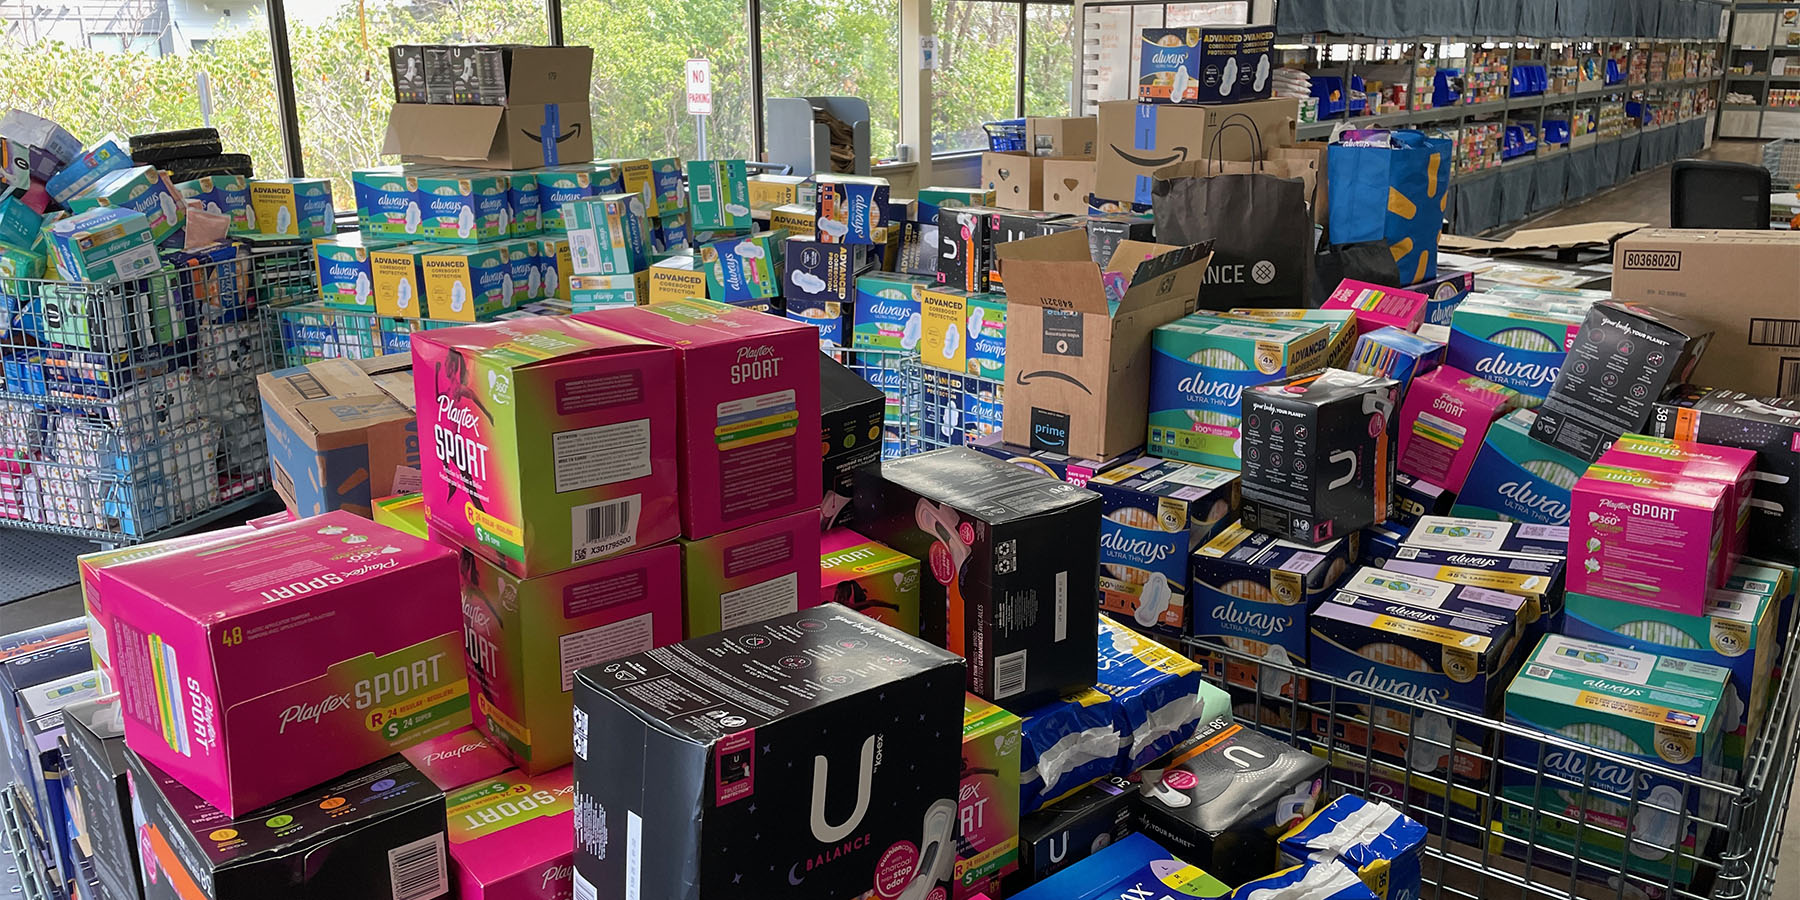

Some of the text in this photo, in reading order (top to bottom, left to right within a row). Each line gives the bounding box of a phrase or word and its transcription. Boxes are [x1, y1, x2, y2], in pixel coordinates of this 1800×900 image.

[1204, 34, 1242, 43] ADVANCED
[398, 48, 404, 57] U
[454, 48, 460, 57] U
[1152, 50, 1184, 67] always
[692, 70, 704, 83] NO
[688, 93, 710, 104] PARKING
[624, 163, 649, 172] ADVANCED
[661, 176, 680, 188] always
[254, 186, 291, 195] ADVANCED
[551, 191, 582, 201] always
[133, 192, 160, 214] always
[304, 199, 331, 214] always
[378, 194, 409, 211] always
[430, 198, 462, 215] always
[480, 198, 502, 211] always
[519, 193, 539, 205] always
[76, 213, 117, 231] always
[774, 216, 815, 227] ADVANCE
[855, 194, 865, 238] always
[629, 213, 641, 254] always
[900, 223, 912, 274] ADVANCED
[943, 236, 957, 259] U
[374, 258, 411, 266] ADVANCED
[1627, 253, 1676, 267] 80368020
[330, 266, 359, 281] always
[480, 271, 504, 287] always
[653, 273, 701, 284] ADVANCED
[724, 253, 741, 291] always
[838, 247, 847, 299] ADVANCED
[1202, 264, 1245, 284] NCE
[659, 281, 695, 289] COREBOOST
[659, 287, 696, 295] PROTECTION
[870, 302, 911, 321] always
[924, 297, 963, 310] ADVANCED
[928, 306, 957, 315] COREBOOST
[928, 312, 958, 322] PROTECTION
[297, 329, 326, 340] always
[1601, 317, 1667, 346] your body, YOUR PLANET
[1290, 340, 1327, 366] ADVANCED
[1326, 325, 1356, 366] ADVANCED
[737, 346, 774, 363] Playtex
[1263, 357, 1274, 365] 4x
[731, 358, 780, 384] SPORT
[1476, 352, 1559, 387] always
[1485, 374, 1529, 387] ULTRA THIN
[1178, 372, 1242, 406] alway
[1187, 394, 1227, 406] ULTRA THIN
[437, 394, 479, 437] Playtex
[1433, 399, 1465, 418] SPORT
[1656, 407, 1669, 421] 38
[1035, 424, 1065, 437] prime
[434, 424, 489, 481] SPORT
[1630, 443, 1681, 457] SPORT
[1605, 473, 1653, 486] SPORT
[1504, 500, 1549, 523] ULTRA THIN
[1599, 498, 1679, 521] Playtex SPORT
[1166, 514, 1177, 522] 4x
[475, 526, 484, 541] S
[1101, 528, 1169, 564] always
[820, 547, 876, 569] SPORT
[1106, 551, 1144, 563] ULTRA THIN
[1447, 554, 1499, 567] always
[260, 573, 344, 604] SPORT
[1281, 587, 1291, 596] 4x
[1212, 601, 1286, 636] always
[1386, 605, 1441, 621] always
[222, 626, 243, 647] 48
[830, 615, 853, 626] your
[850, 620, 876, 636] body,
[875, 630, 899, 644] YOUR
[1221, 622, 1260, 636] ULTRA THIN
[1721, 636, 1737, 645] 4x
[1452, 663, 1465, 672] 4x
[354, 653, 443, 710] SPORT
[1347, 667, 1440, 703] always
[1583, 678, 1644, 696] always
[187, 677, 209, 751] SPORT
[279, 692, 351, 734] Playtex
[371, 699, 423, 728] R 24 REGULAR
[387, 712, 432, 737] S 24 SUPER
[422, 741, 488, 766] Playtex
[1665, 742, 1682, 752] 4x
[733, 754, 740, 763] U
[1544, 751, 1653, 792] always
[492, 784, 505, 793] S
[513, 785, 527, 794] R
[723, 781, 748, 795] TRUSTED
[810, 734, 875, 843] U
[1113, 776, 1131, 789] 30
[465, 789, 556, 830] SPORT
[1151, 823, 1192, 848] YOUR PLANET
[806, 834, 872, 872] BALANCE
[1050, 831, 1067, 864] U
[881, 856, 912, 875] charcoal
[893, 865, 912, 879] stop
[955, 864, 963, 877] R
[886, 877, 905, 890] odor
[965, 868, 983, 884] S 24
